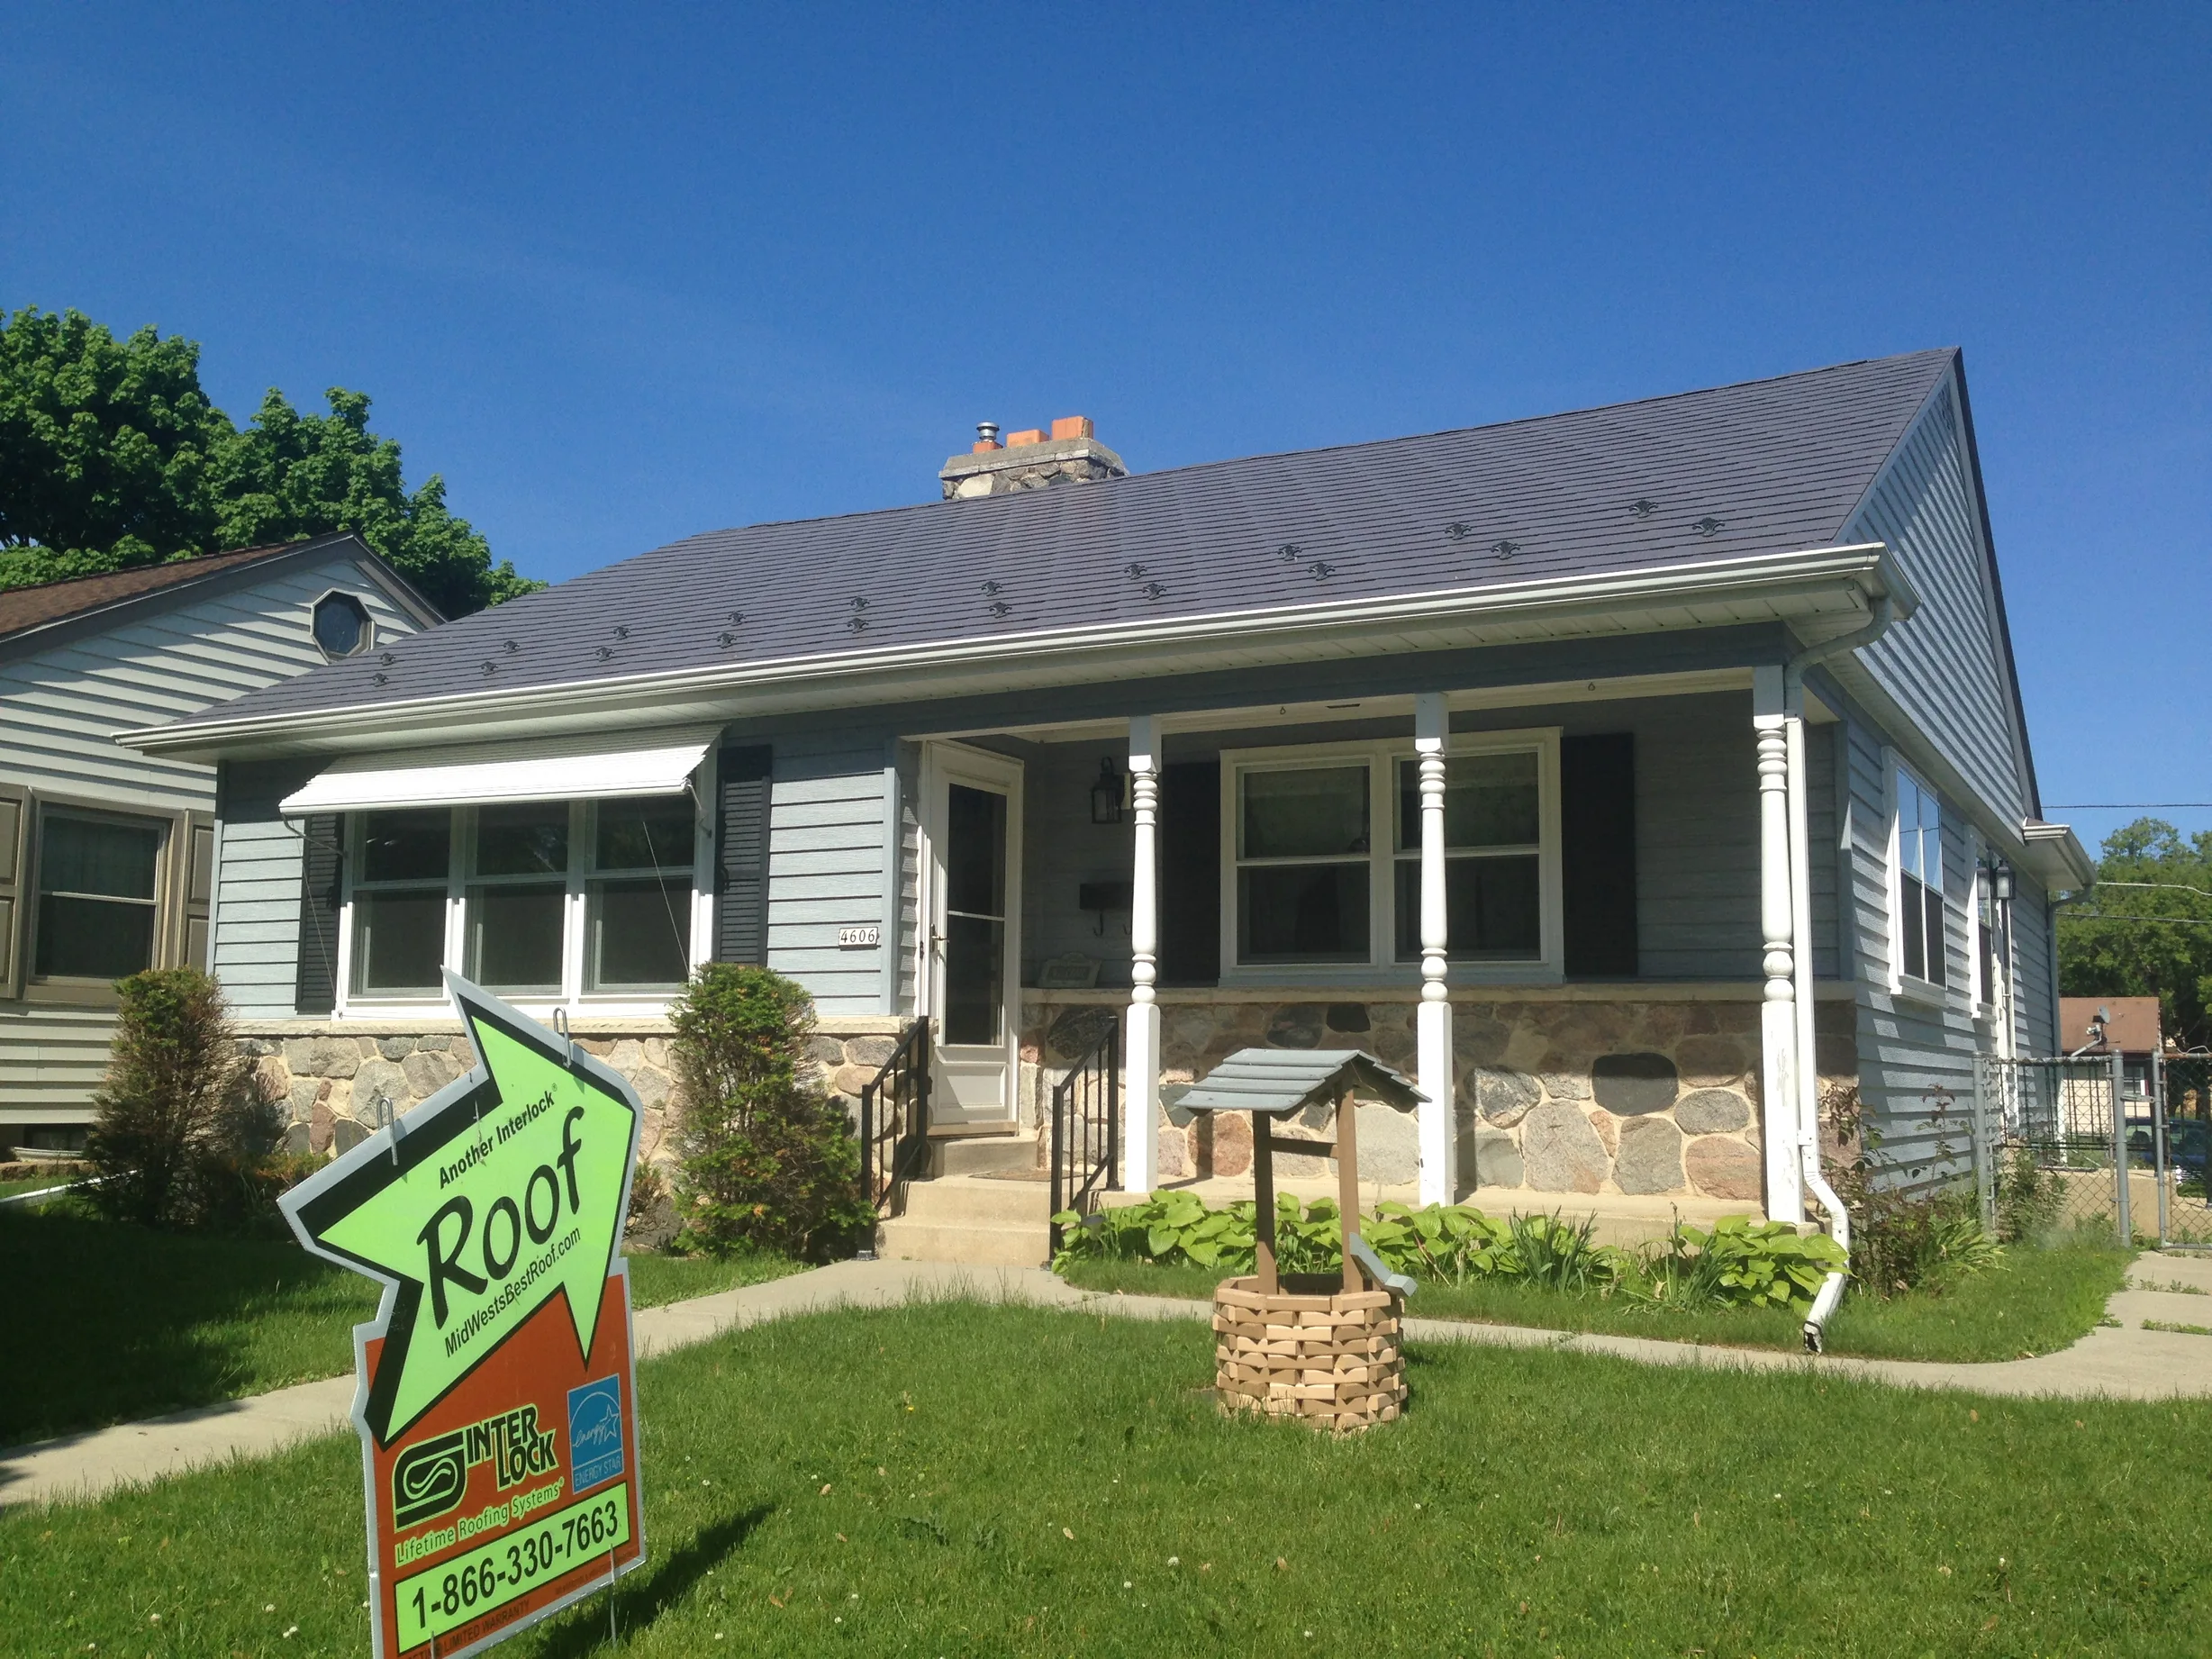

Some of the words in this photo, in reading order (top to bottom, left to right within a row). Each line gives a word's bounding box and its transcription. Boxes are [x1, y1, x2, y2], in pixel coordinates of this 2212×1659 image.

[839, 929, 875, 943] 4606
[439, 1137, 494, 1190] Another
[444, 1227, 582, 1358] MidWestsBestRoof.com
[466, 1406, 539, 1465] INTER
[496, 1432, 558, 1489] LOCK
[575, 1461, 603, 1488] ENERGY
[603, 1455, 622, 1474] STAR
[396, 1528, 455, 1564] Lifetime
[458, 1506, 510, 1537] Roofing
[411, 1500, 619, 1629] 1-866-330-7663
[444, 1626, 481, 1654] LIMITED
[483, 1599, 530, 1630] WARRANTY
